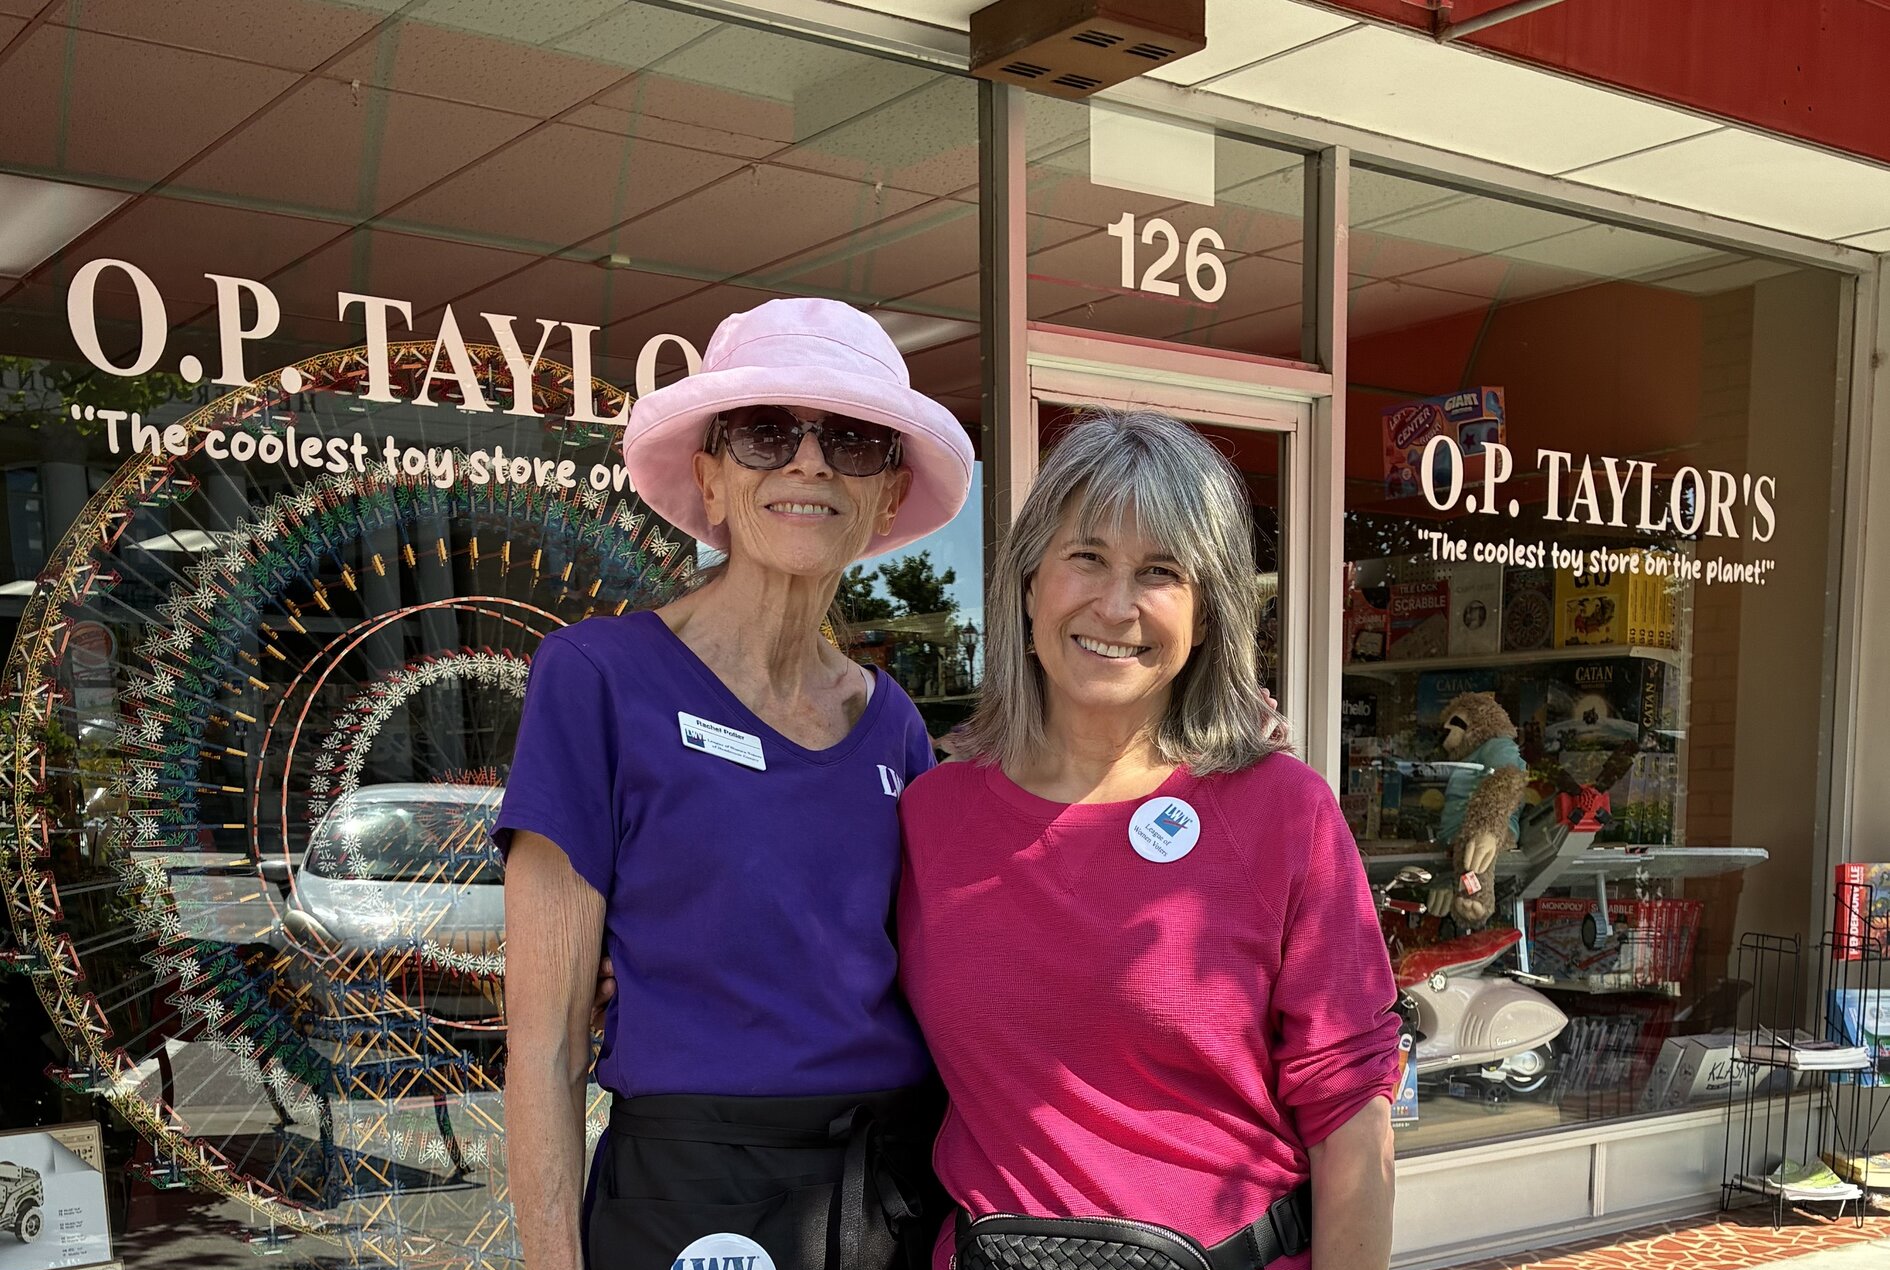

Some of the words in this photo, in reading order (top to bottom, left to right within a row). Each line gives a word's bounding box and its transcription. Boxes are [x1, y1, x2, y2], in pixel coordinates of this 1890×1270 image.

[1107, 212, 1228, 303] 126
[67, 258, 303, 394] O.P.
[1444, 392, 1479, 412] GIANT
[1396, 407, 1432, 446] CENTER
[205, 425, 368, 474] coolest
[384, 435, 455, 489] toy
[470, 447, 577, 492] store
[1420, 434, 1520, 518] O.P.
[1537, 448, 1776, 542] TAYLOR'S
[1473, 540, 1547, 570] coolest
[1550, 540, 1584, 578] toy
[1589, 546, 1640, 575] store
[1644, 553, 1669, 577] on
[1673, 552, 1702, 580] the
[1393, 595, 1446, 613] SCRABBLE
[1416, 583, 1438, 593] LOCK
[1575, 665, 1614, 682] CATAN
[1642, 682, 1656, 728] CATAN
[1133, 825, 1152, 844] Women
[1152, 840, 1168, 857] Voters
[1145, 823, 1164, 842] League
[1163, 838, 1172, 847] of
[1541, 901, 1583, 912] MONOPOLY
[1590, 903, 1634, 914] SABBLE
